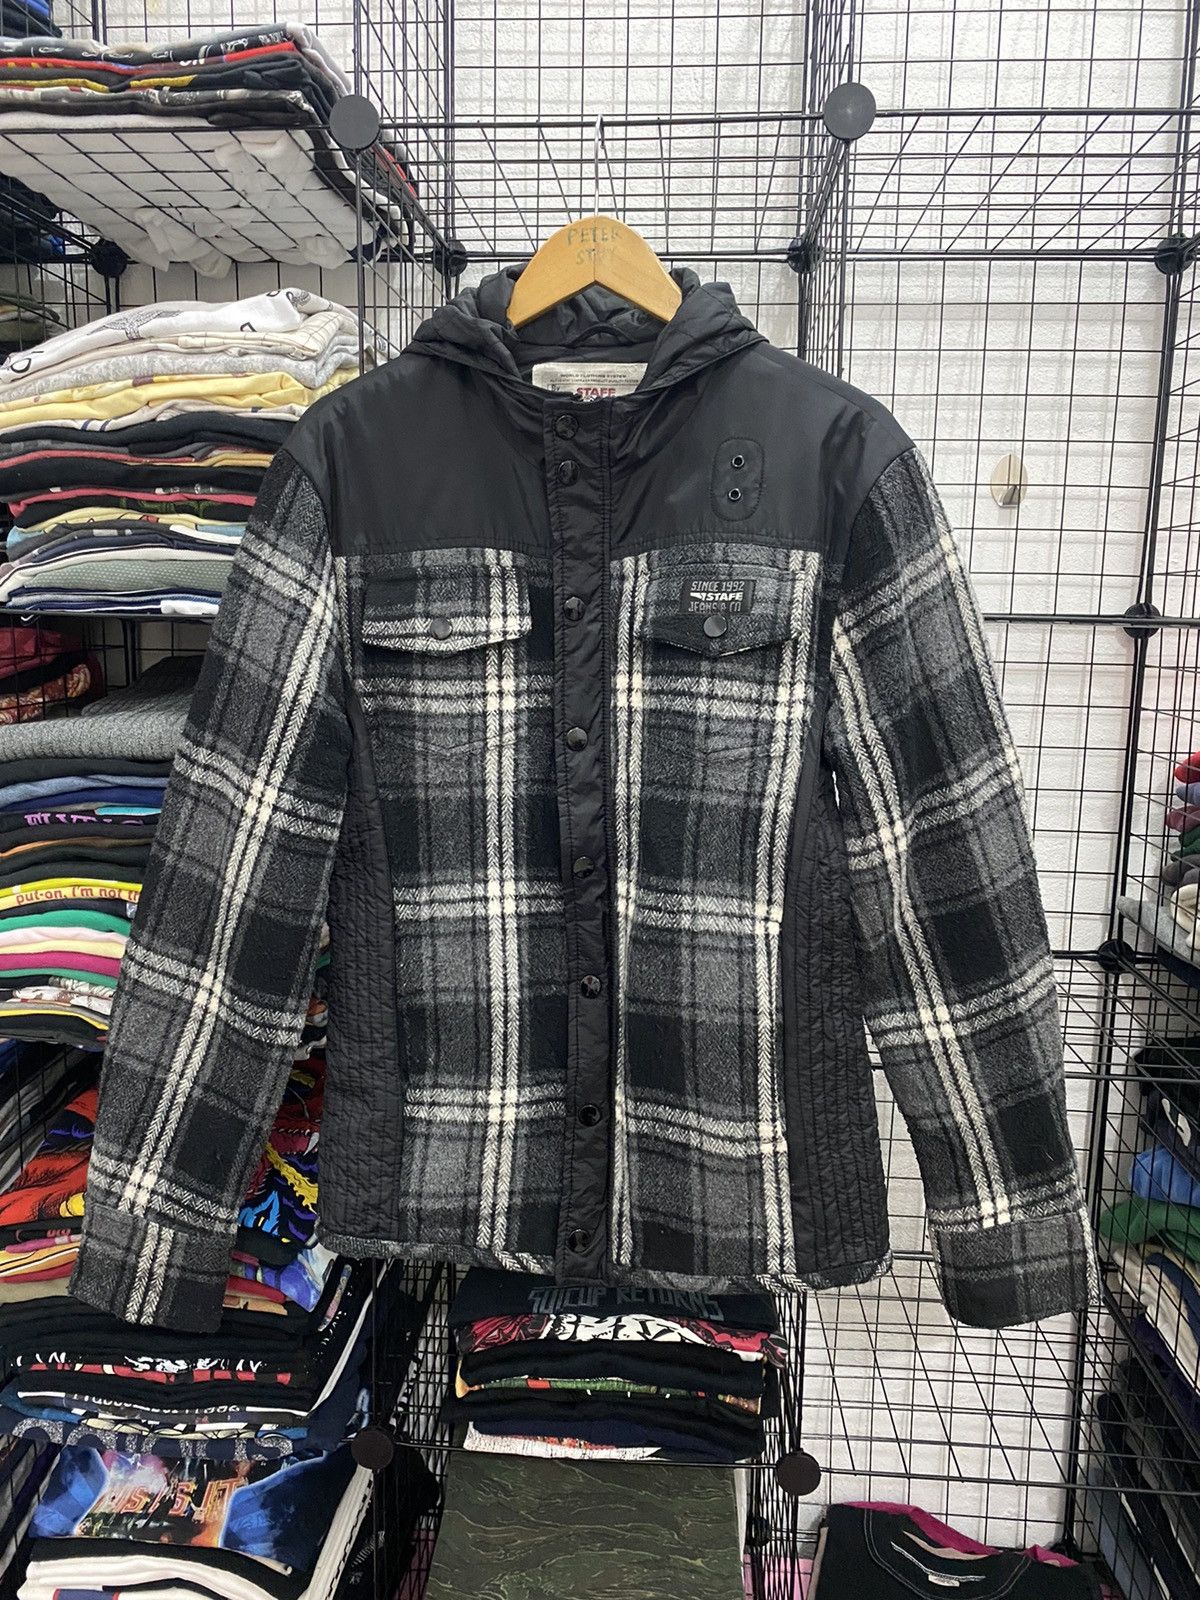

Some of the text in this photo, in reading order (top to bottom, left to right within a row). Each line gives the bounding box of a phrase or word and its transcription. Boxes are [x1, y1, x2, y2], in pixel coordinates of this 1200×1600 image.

[576, 387, 616, 397] STAFF
[690, 580, 745, 592] SINCE 1992
[71, 885, 95, 897] I'm
[99, 886, 121, 899] not
